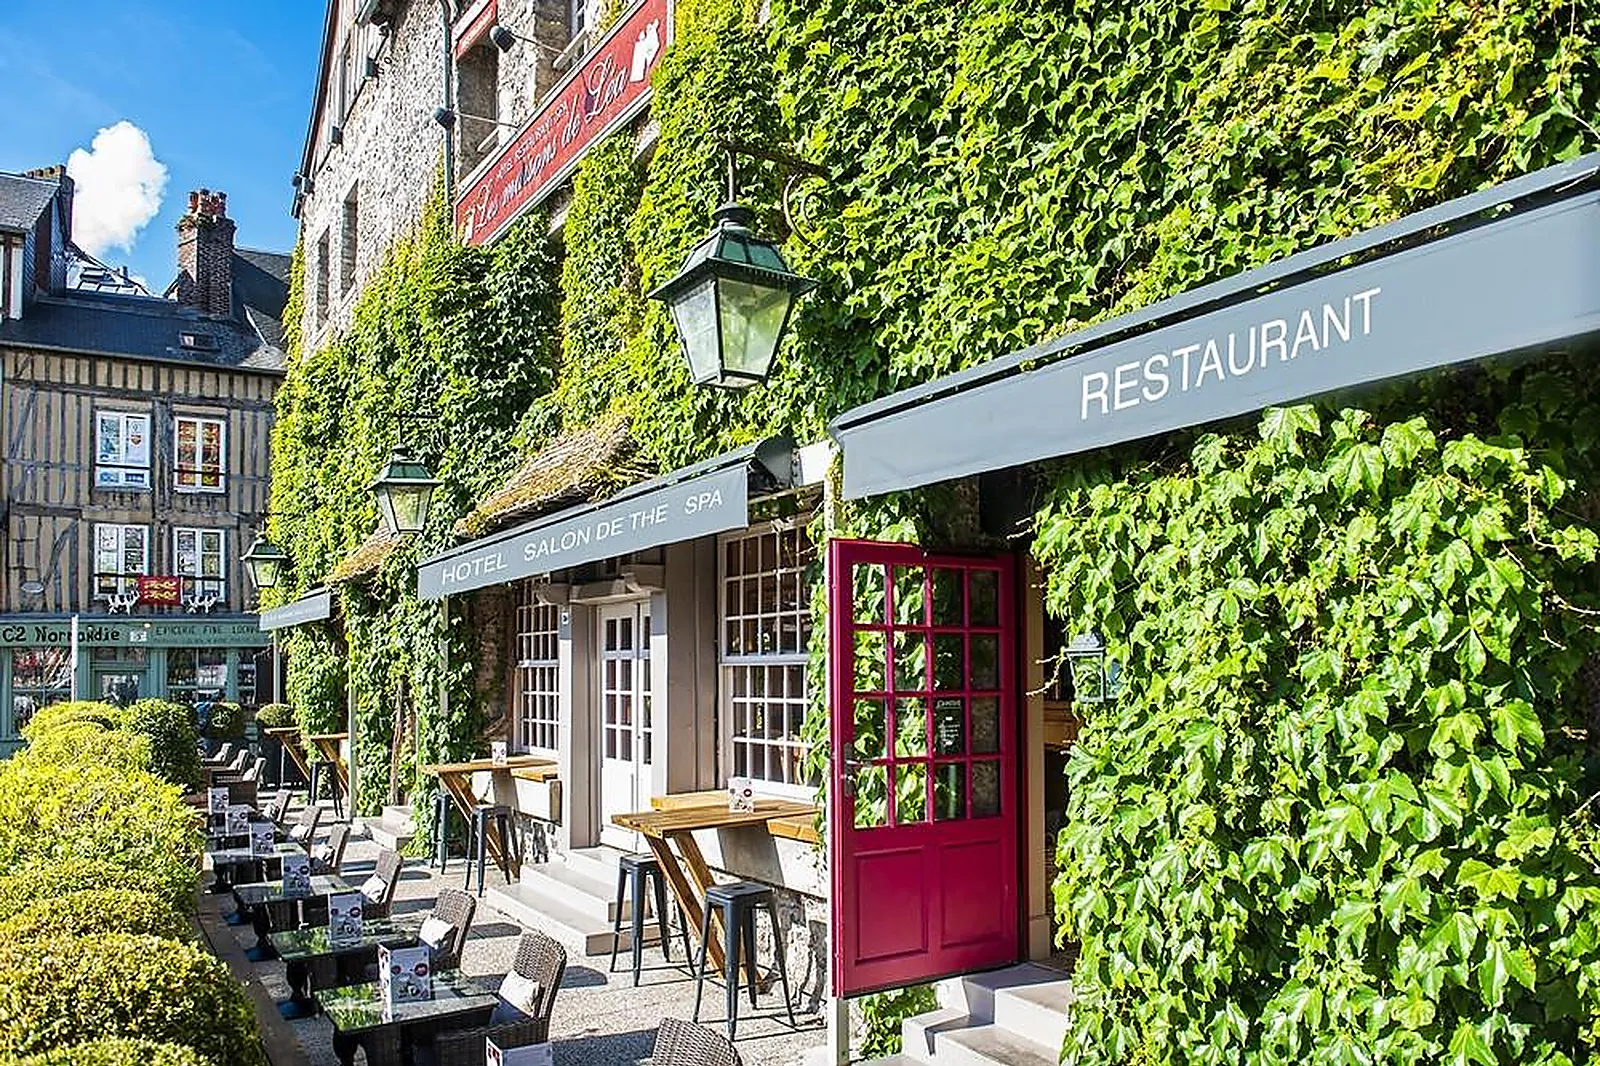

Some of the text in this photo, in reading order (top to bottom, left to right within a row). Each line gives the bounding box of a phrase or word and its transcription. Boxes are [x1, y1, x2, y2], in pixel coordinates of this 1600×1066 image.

[561, 94, 582, 147] de
[1080, 287, 1381, 420] RESTAURANT
[442, 489, 723, 585] HOTEL SALON DE THE SPA
[2, 626, 27, 643] C2
